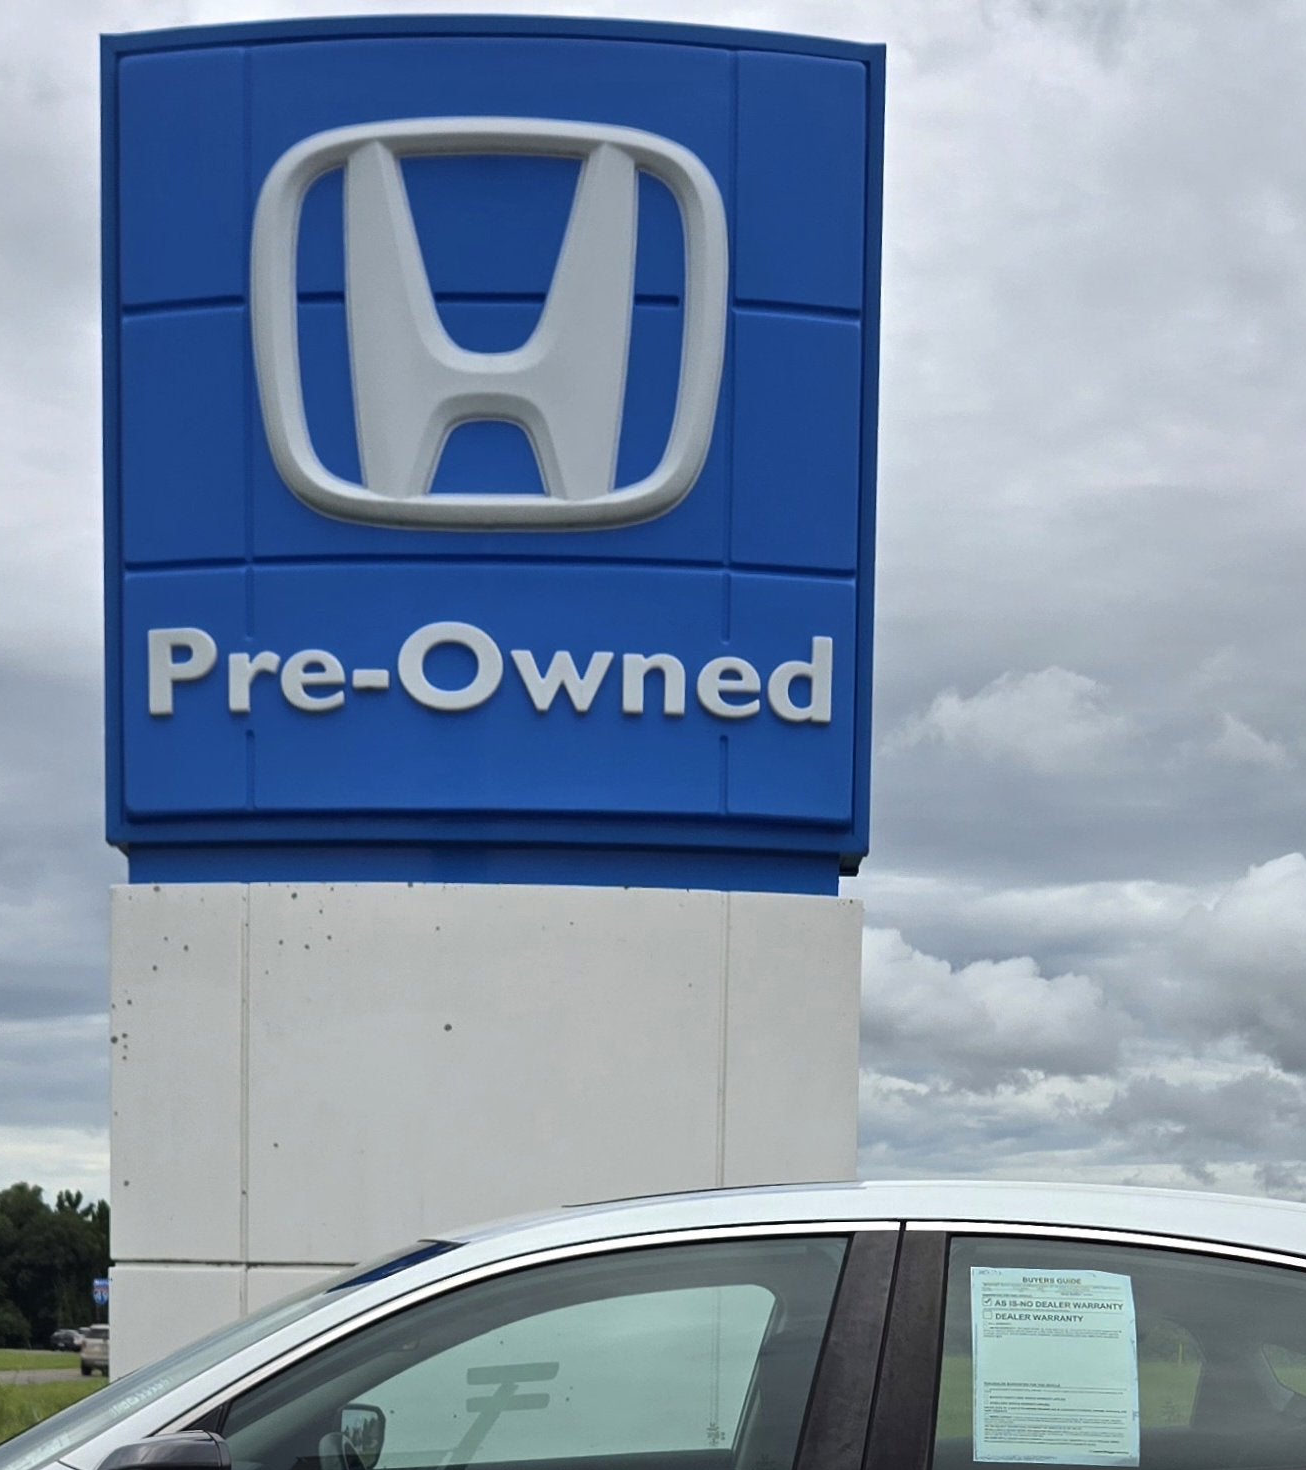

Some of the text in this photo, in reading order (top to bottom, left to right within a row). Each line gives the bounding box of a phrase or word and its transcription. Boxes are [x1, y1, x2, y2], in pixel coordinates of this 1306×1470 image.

[147, 621, 834, 723] Pre-Owned
[1022, 1276, 1082, 1285] BUYERS GUIDE
[1035, 1301, 1071, 1309] DEALER
[1072, 1302, 1124, 1311] WARRANTY
[995, 1312, 1084, 1322] DEALER WARRANTY
